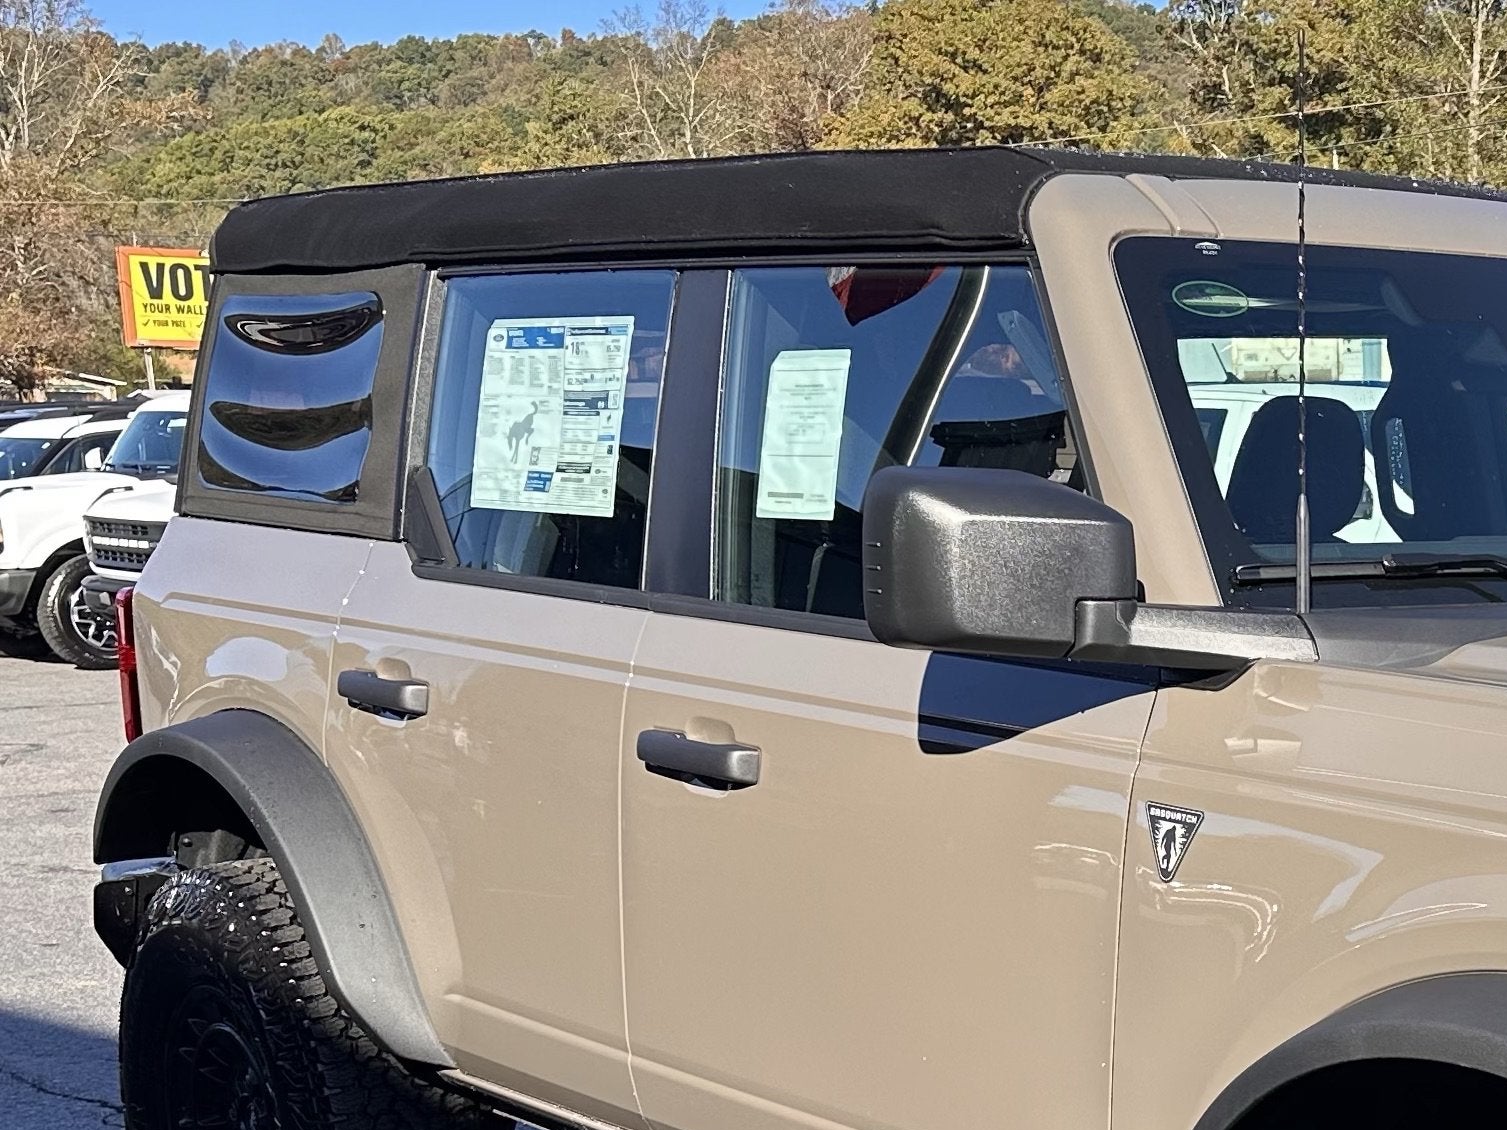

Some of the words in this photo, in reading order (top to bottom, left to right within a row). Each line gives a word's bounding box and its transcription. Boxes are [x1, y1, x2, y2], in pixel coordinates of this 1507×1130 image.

[142, 302, 171, 314] YOUR
[174, 304, 208, 316] WALL
[1149, 807, 1198, 824] SASQUATCH
